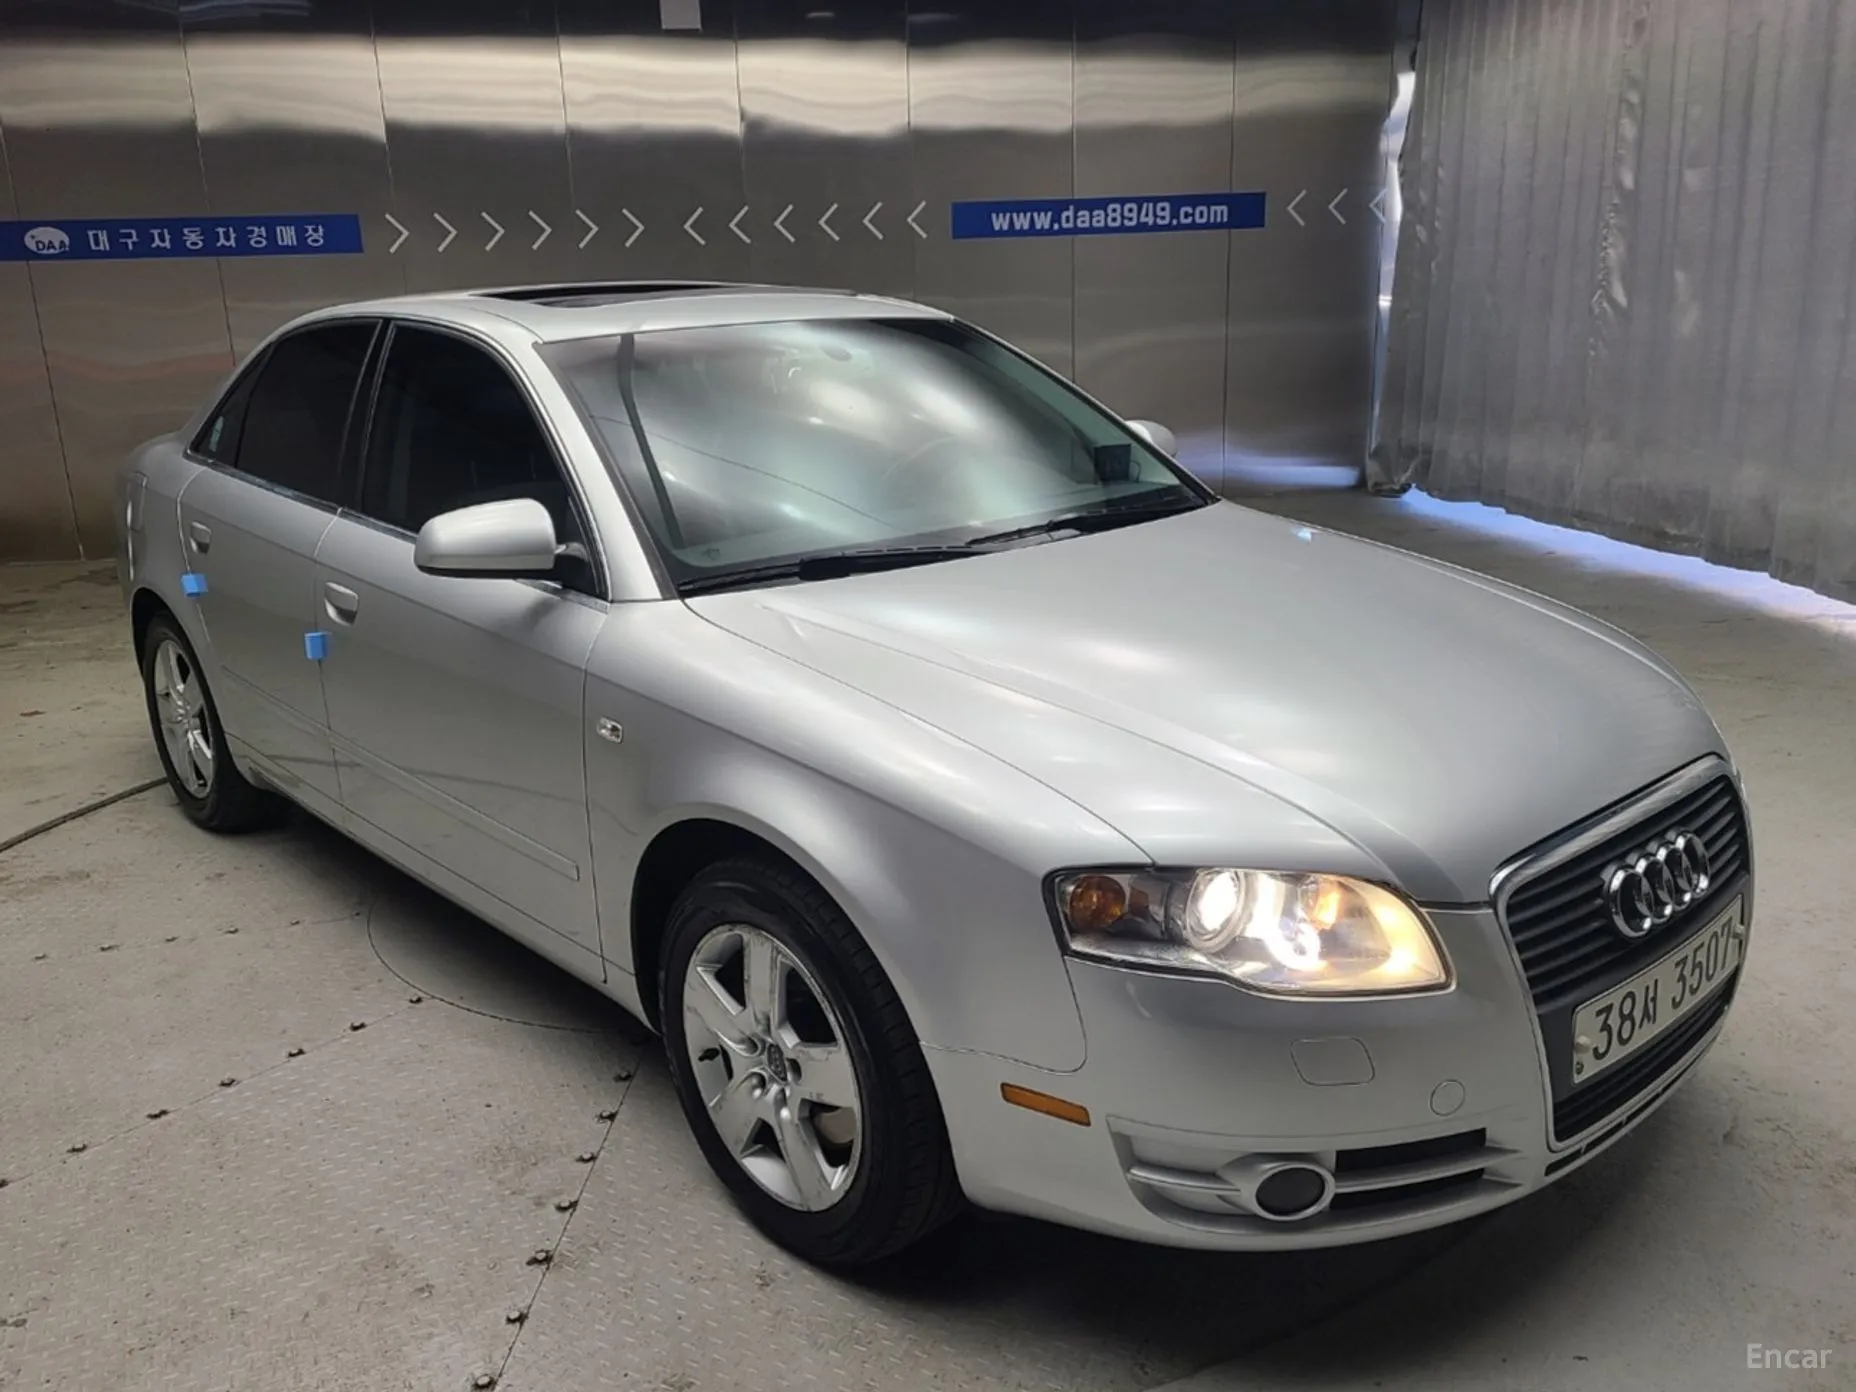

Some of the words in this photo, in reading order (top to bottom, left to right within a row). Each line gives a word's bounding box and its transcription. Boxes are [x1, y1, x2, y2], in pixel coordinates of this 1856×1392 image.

[991, 202, 1229, 231] www.daa8949.com
[1592, 978, 1659, 1061] 38서
[1671, 916, 1733, 1010] 3507
